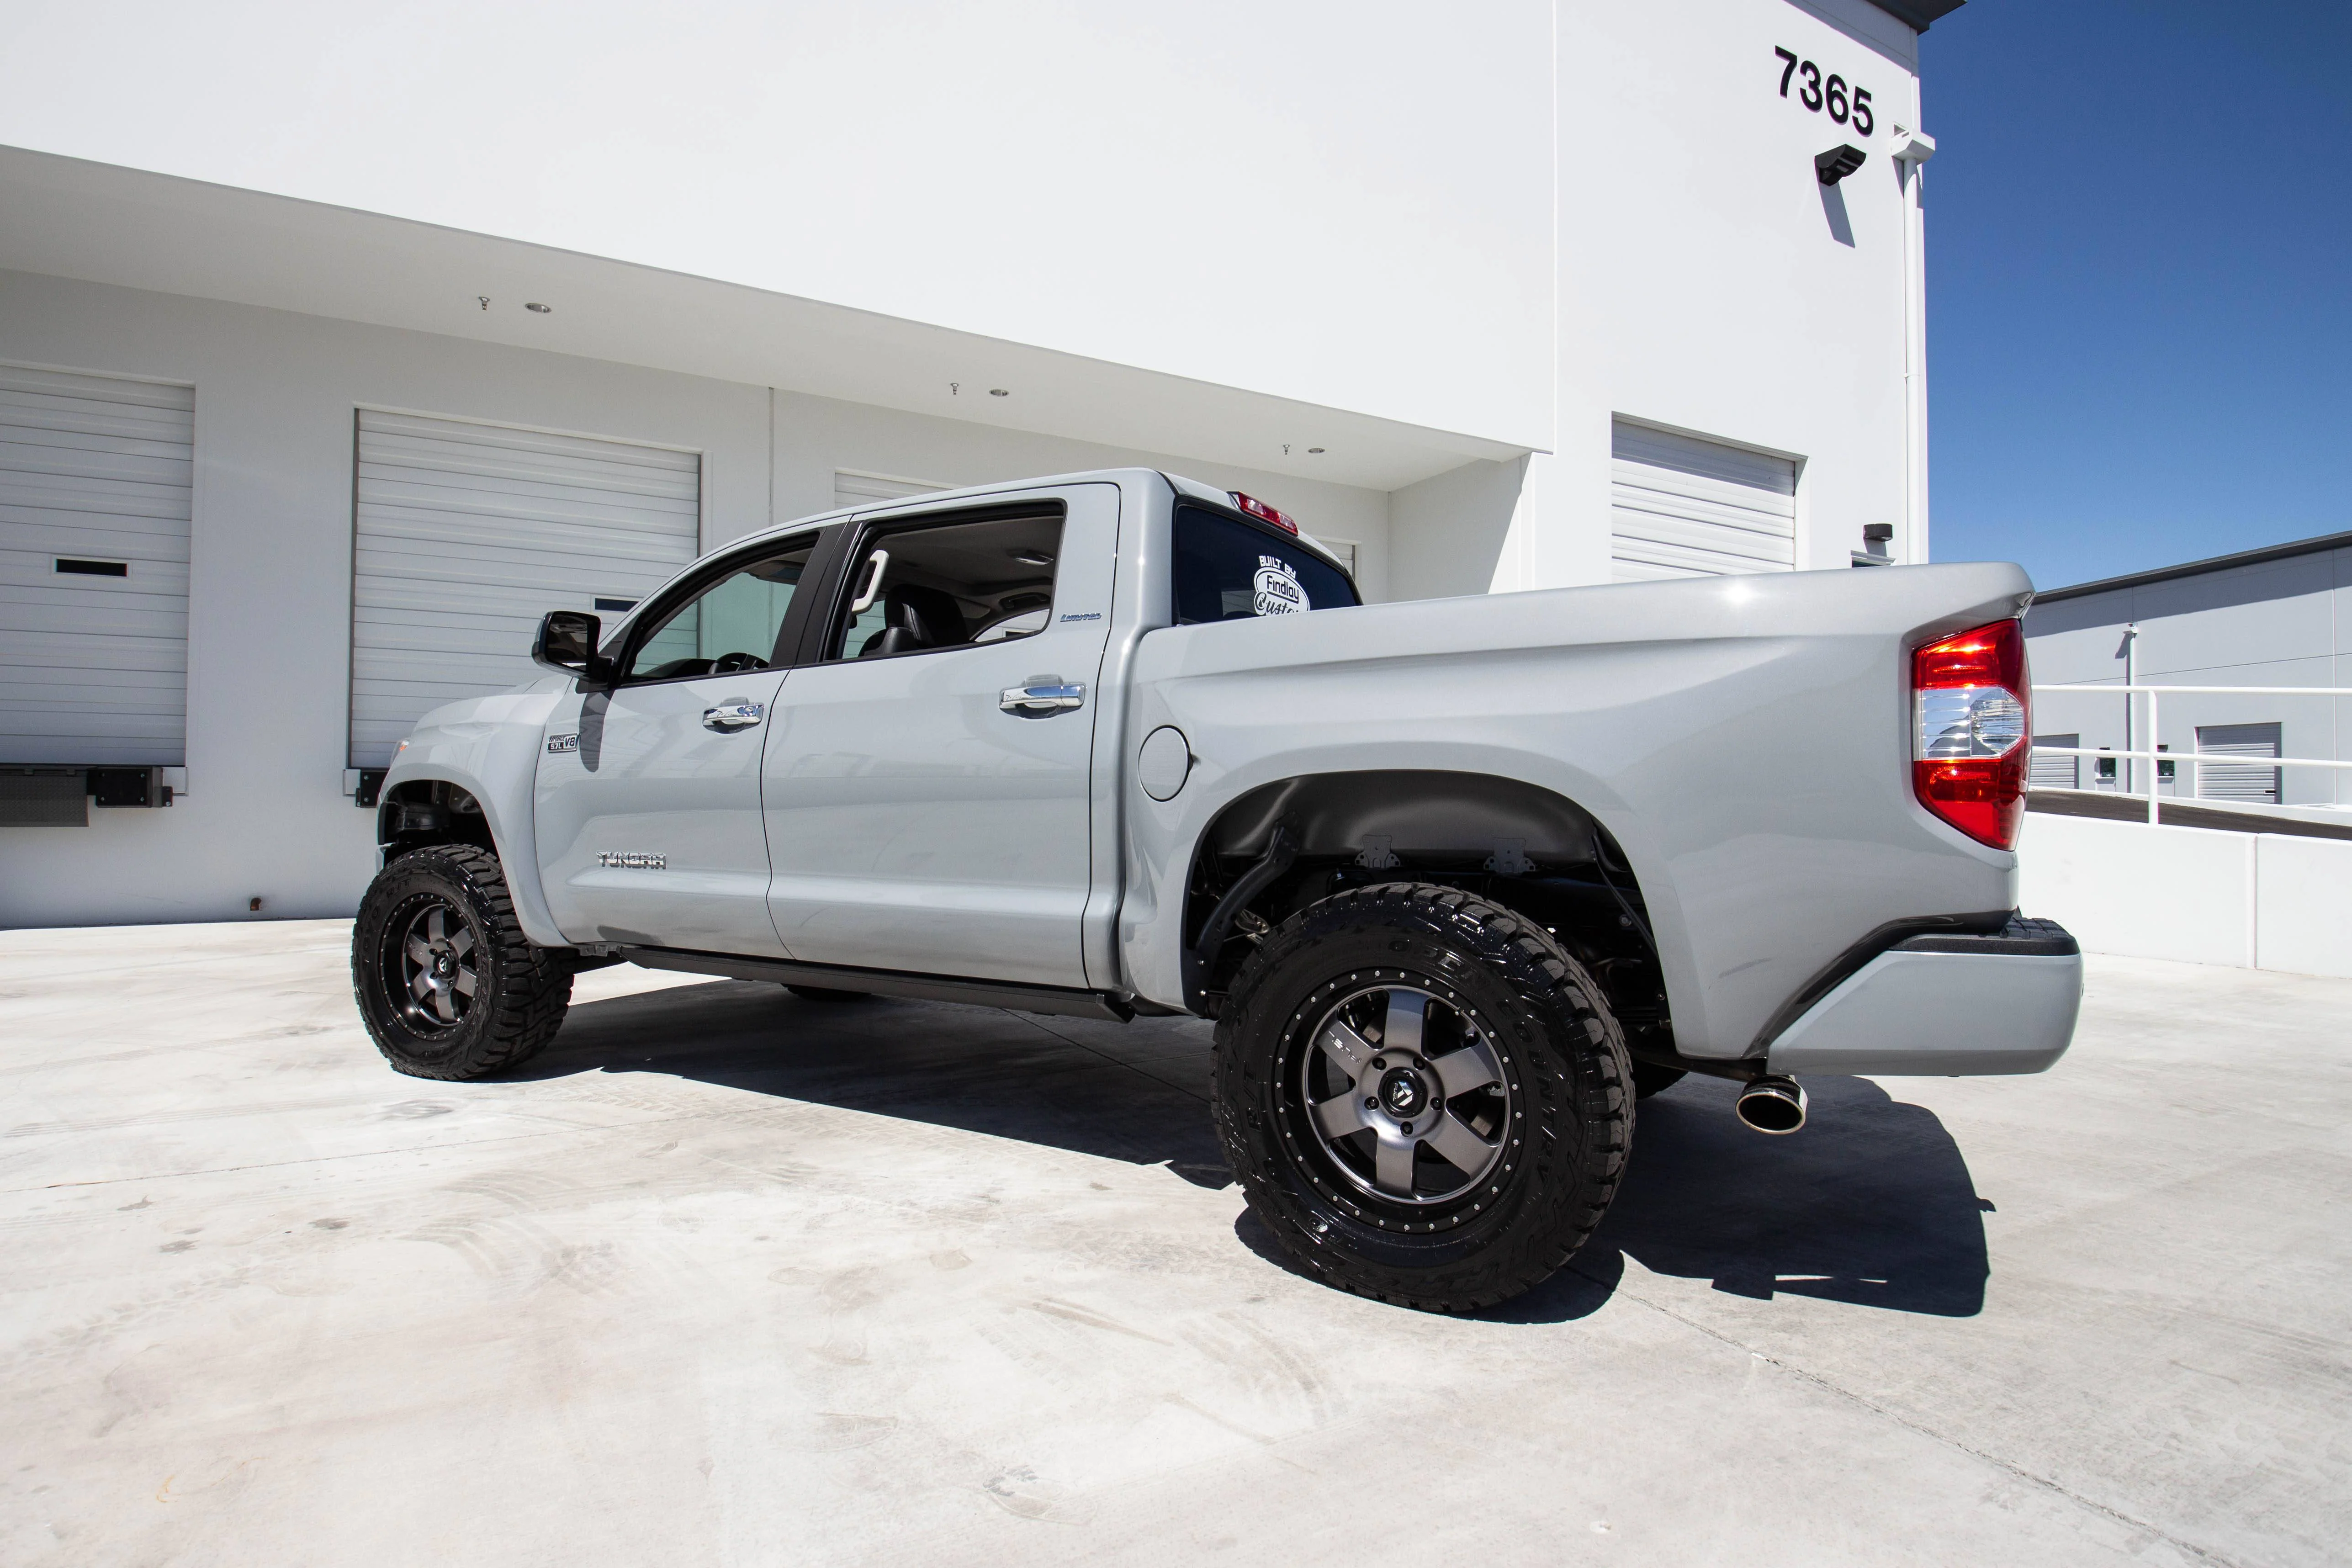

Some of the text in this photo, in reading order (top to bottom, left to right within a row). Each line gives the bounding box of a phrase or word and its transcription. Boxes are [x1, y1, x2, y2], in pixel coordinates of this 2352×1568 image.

[1775, 45, 1874, 137] 7365
[1259, 556, 1296, 578] BUILT BY
[1267, 575, 1299, 601] Findlay
[565, 737, 575, 747] V8
[596, 851, 667, 869] TUNDRA
[1329, 1031, 1361, 1064] FUEL
[1495, 1001, 1557, 1184] COUNTRY
